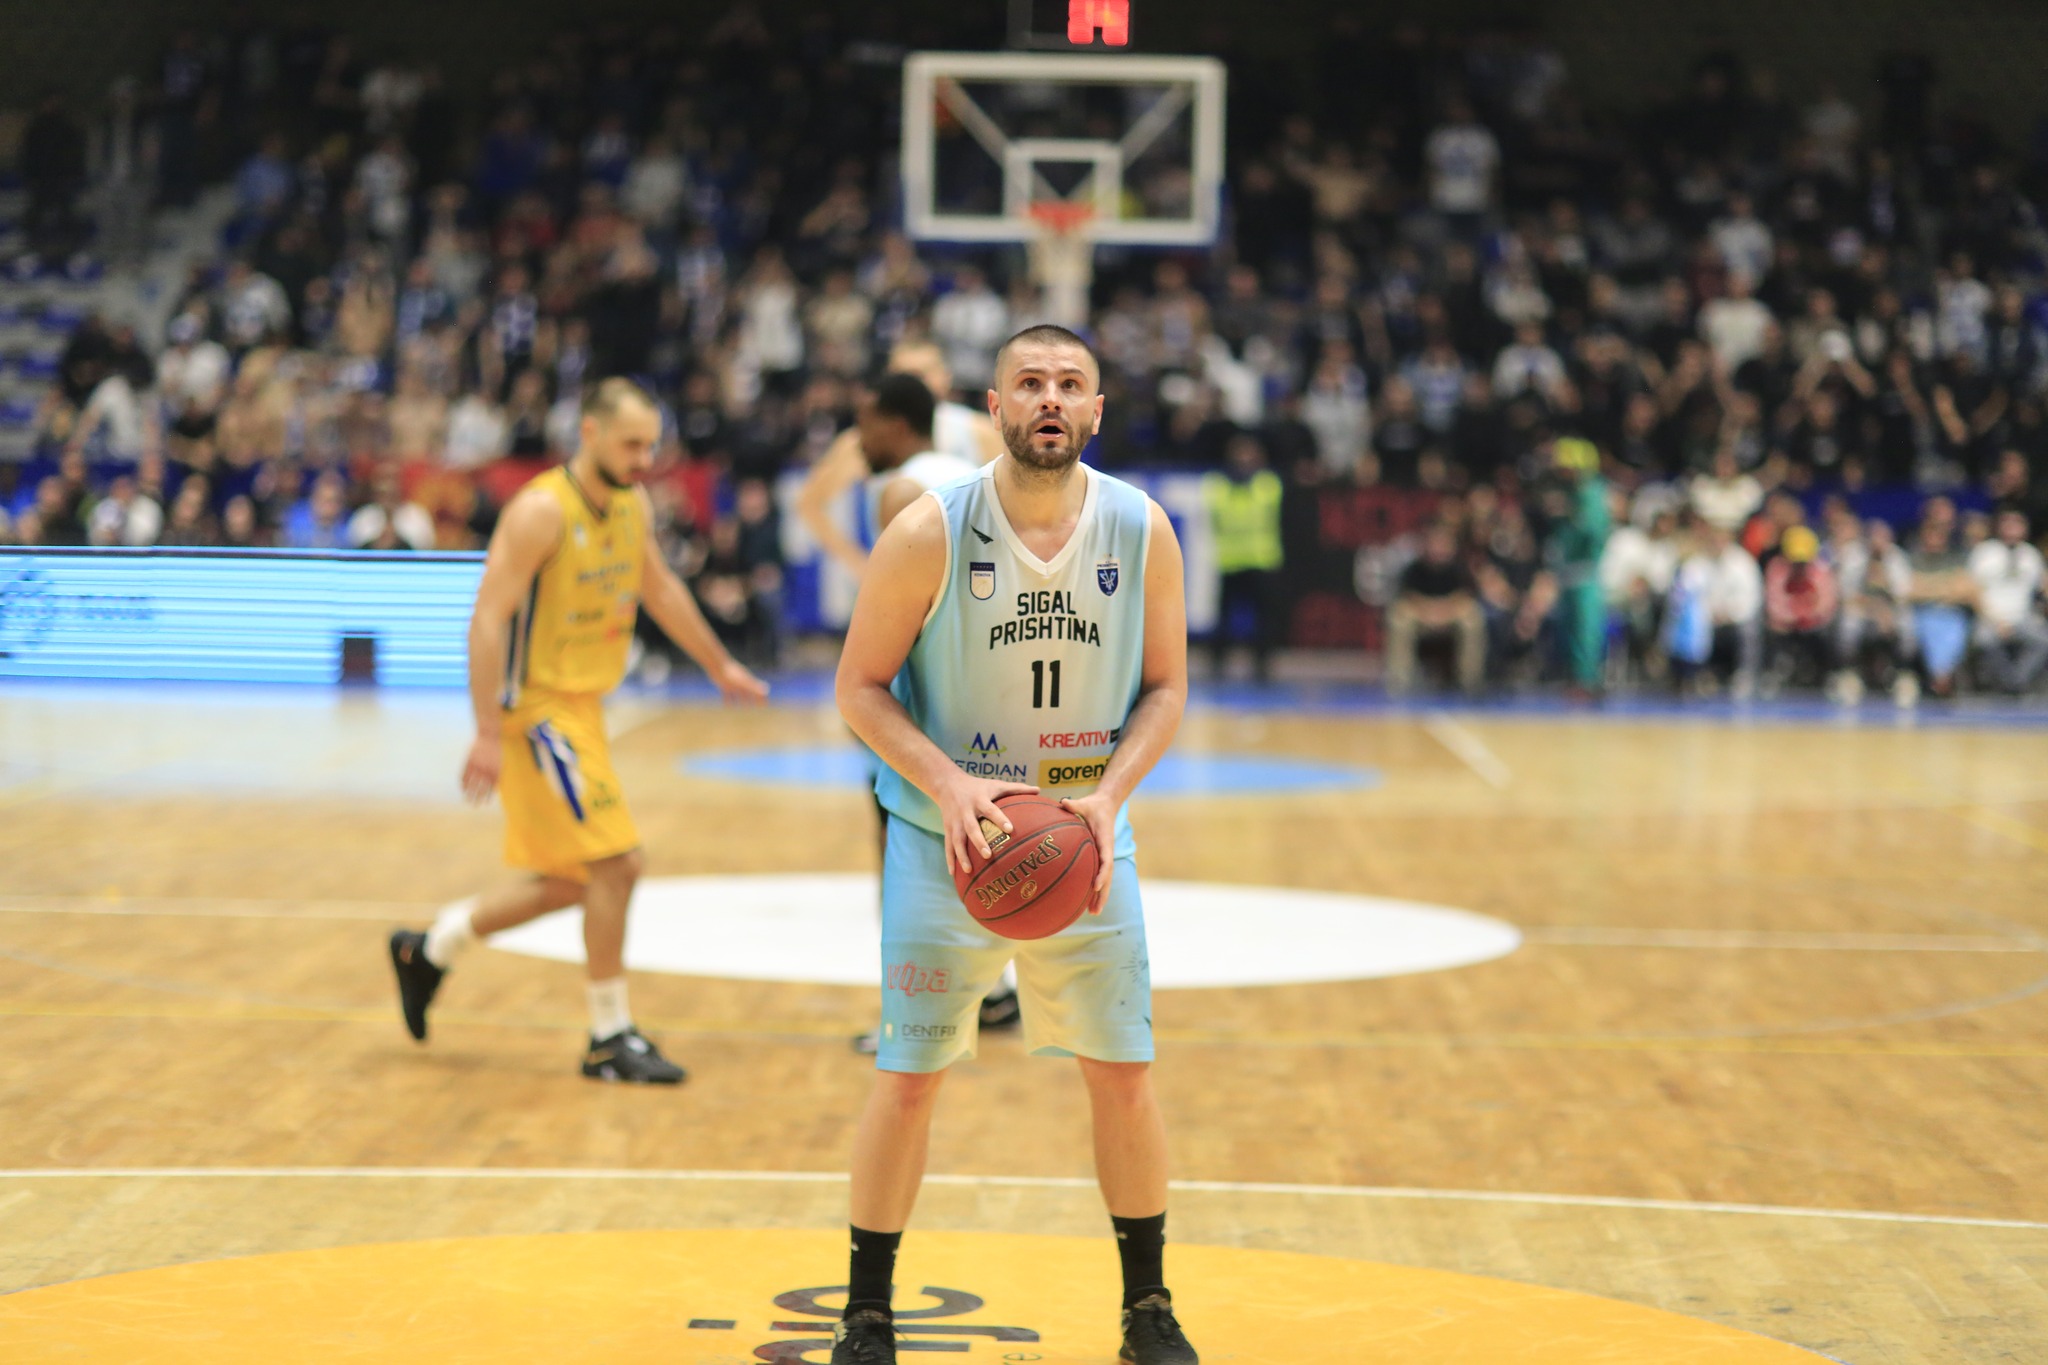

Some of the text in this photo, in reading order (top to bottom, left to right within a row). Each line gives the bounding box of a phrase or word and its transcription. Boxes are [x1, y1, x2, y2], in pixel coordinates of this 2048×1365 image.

[1017, 590, 1076, 616] SIGAL
[990, 616, 1100, 650] PRISHTINA
[1032, 660, 1060, 708] 11
[953, 759, 1026, 776] ERIDIAN
[975, 835, 1062, 910] SPALDING
